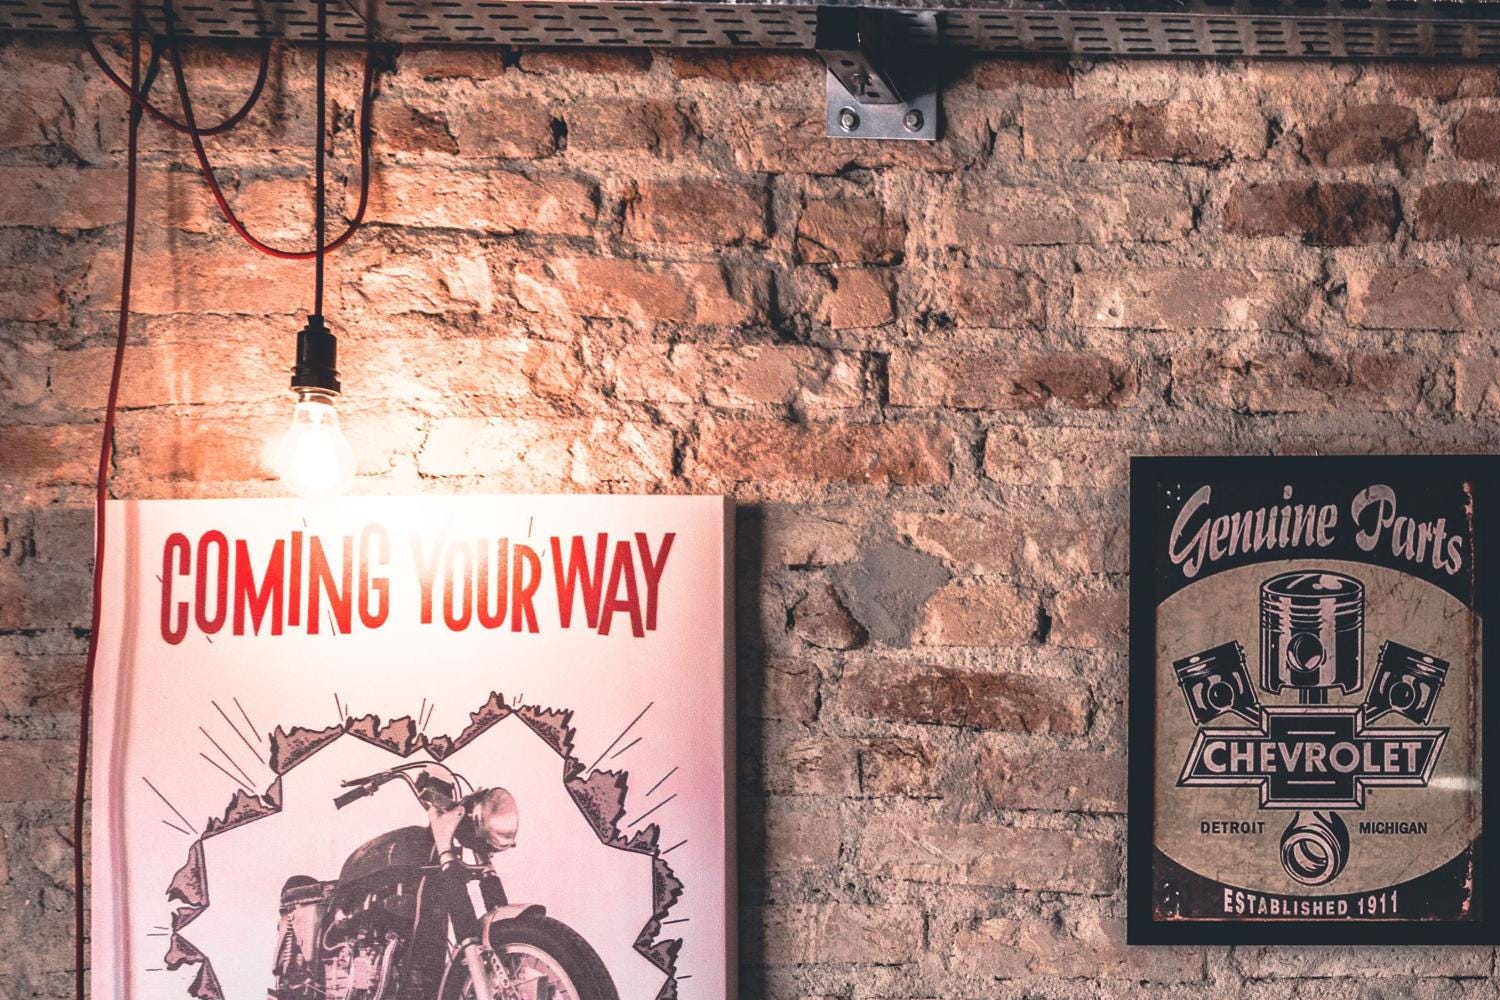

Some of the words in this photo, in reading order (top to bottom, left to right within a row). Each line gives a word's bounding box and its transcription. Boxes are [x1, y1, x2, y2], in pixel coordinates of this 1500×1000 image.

[1169, 485, 1338, 577] Genuine
[1351, 485, 1463, 575] Parts
[160, 522, 391, 645] COMING
[409, 530, 540, 634] YOUR
[550, 532, 676, 638] WAY
[1203, 741, 1422, 775] CHEVROLET
[1200, 820, 1265, 835] DETROIT
[1358, 820, 1428, 835] MICHIGAN
[1223, 888, 1348, 916] ESTABLISHED
[1357, 889, 1399, 915] 1911
